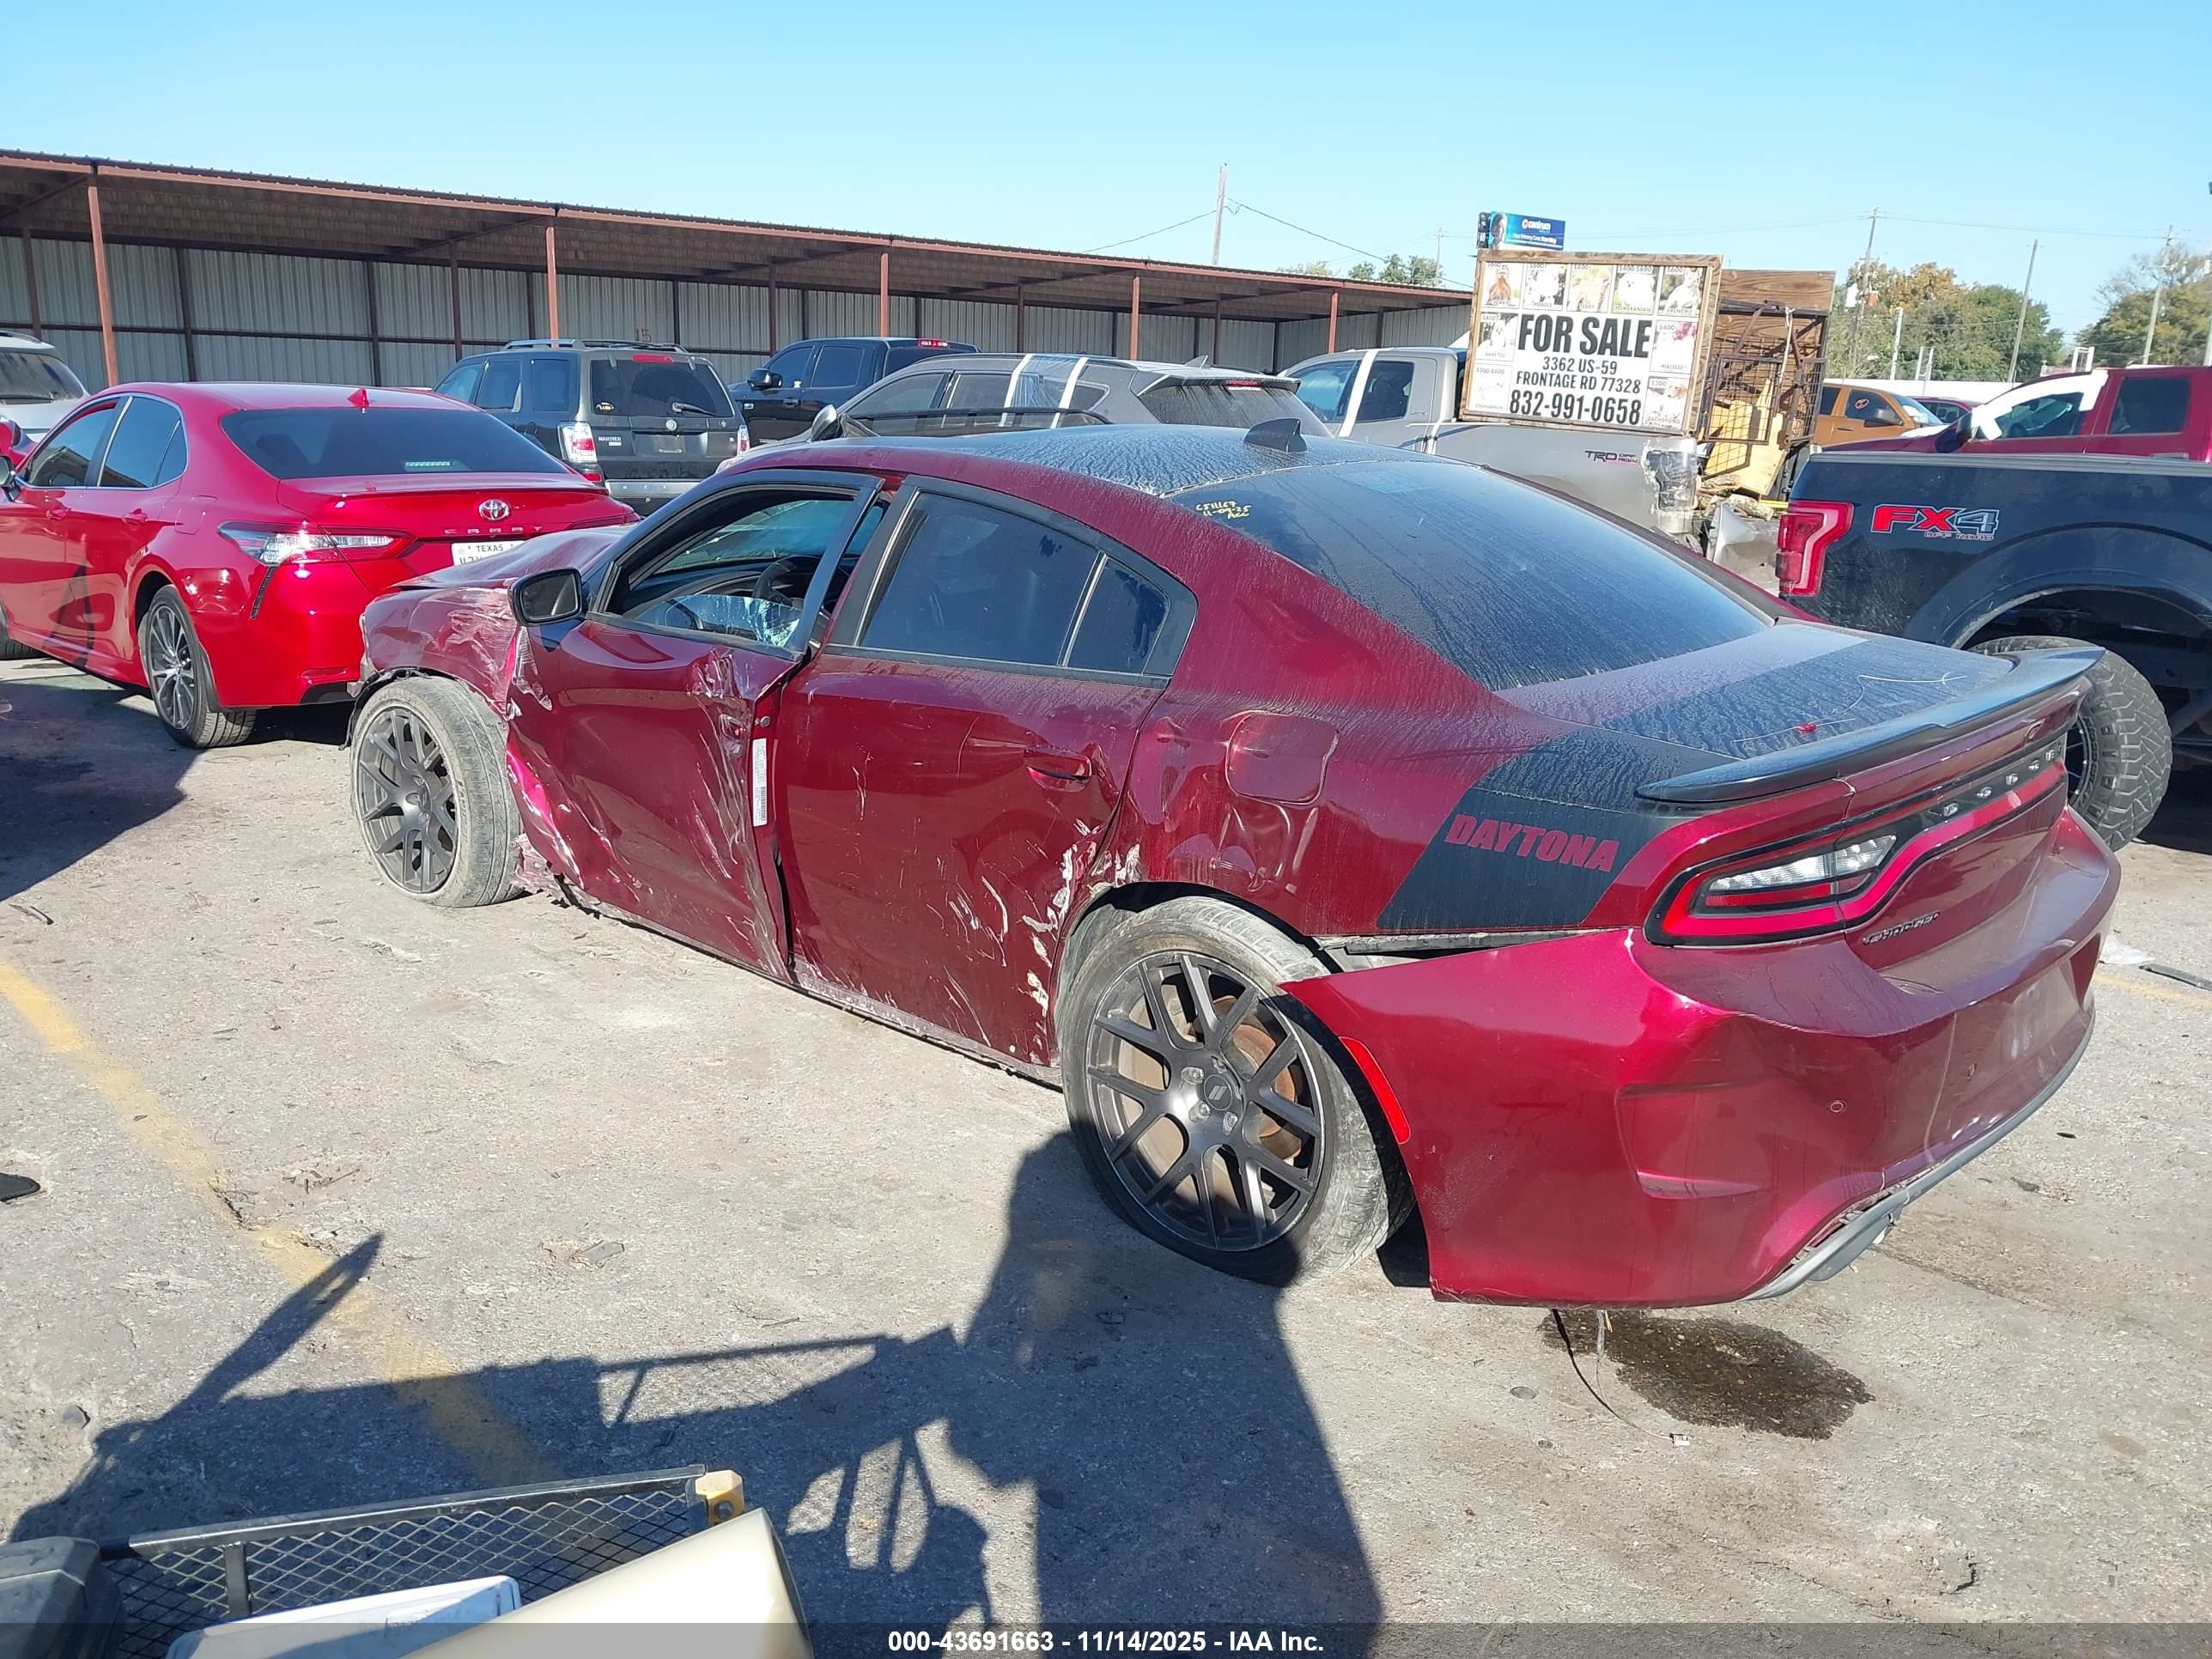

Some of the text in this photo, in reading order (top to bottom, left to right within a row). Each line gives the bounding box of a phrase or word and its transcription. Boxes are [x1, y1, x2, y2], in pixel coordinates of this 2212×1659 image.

[1518, 314, 1652, 358] FOR SALE
[1542, 356, 1618, 374] 3362 US-59
[1516, 371, 1641, 394] FRONTAGE RD 77328
[1510, 389, 1642, 425] 832-991-0658
[1584, 450, 1617, 462] TRD
[1870, 503, 2000, 534] FX4
[476, 544, 504, 553] TEXAS
[1444, 814, 1620, 872] DAYTONA
